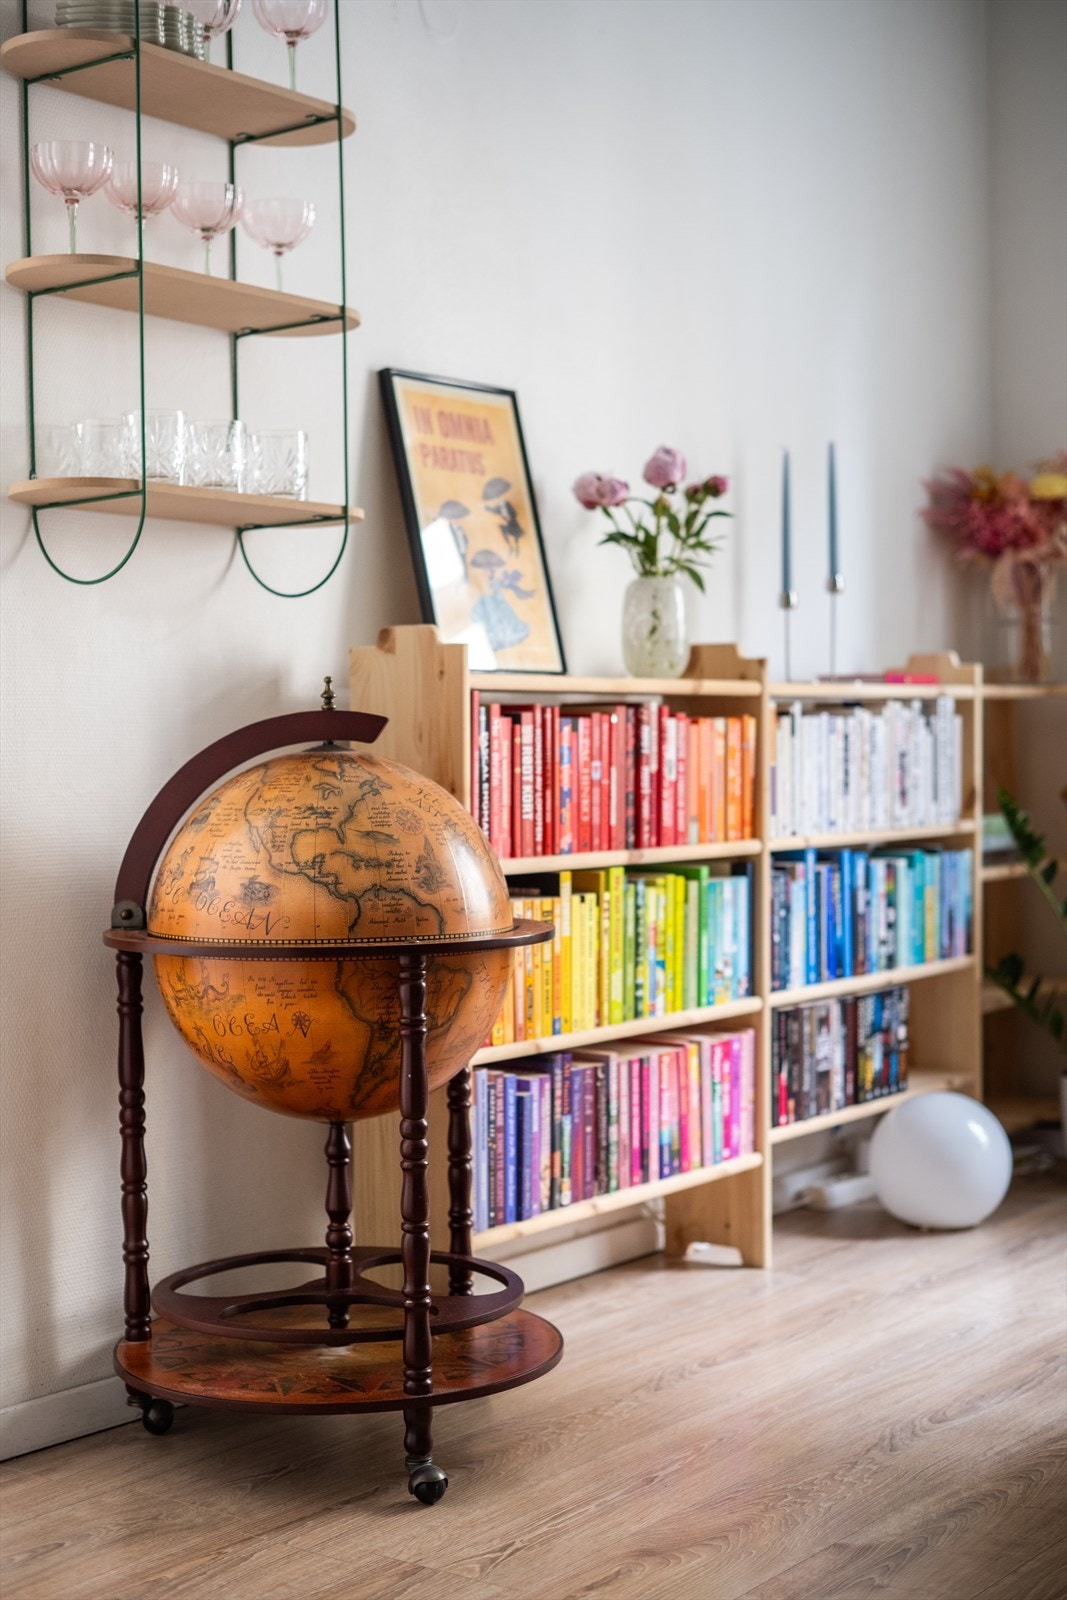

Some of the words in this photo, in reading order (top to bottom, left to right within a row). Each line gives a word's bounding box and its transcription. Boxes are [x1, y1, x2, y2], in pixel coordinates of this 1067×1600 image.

[412, 406, 434, 435] IN
[437, 410, 496, 446] OMNIA
[419, 443, 486, 476] PARATUS
[521, 784, 534, 821] KORT
[212, 1010, 320, 1039] OCEAN
